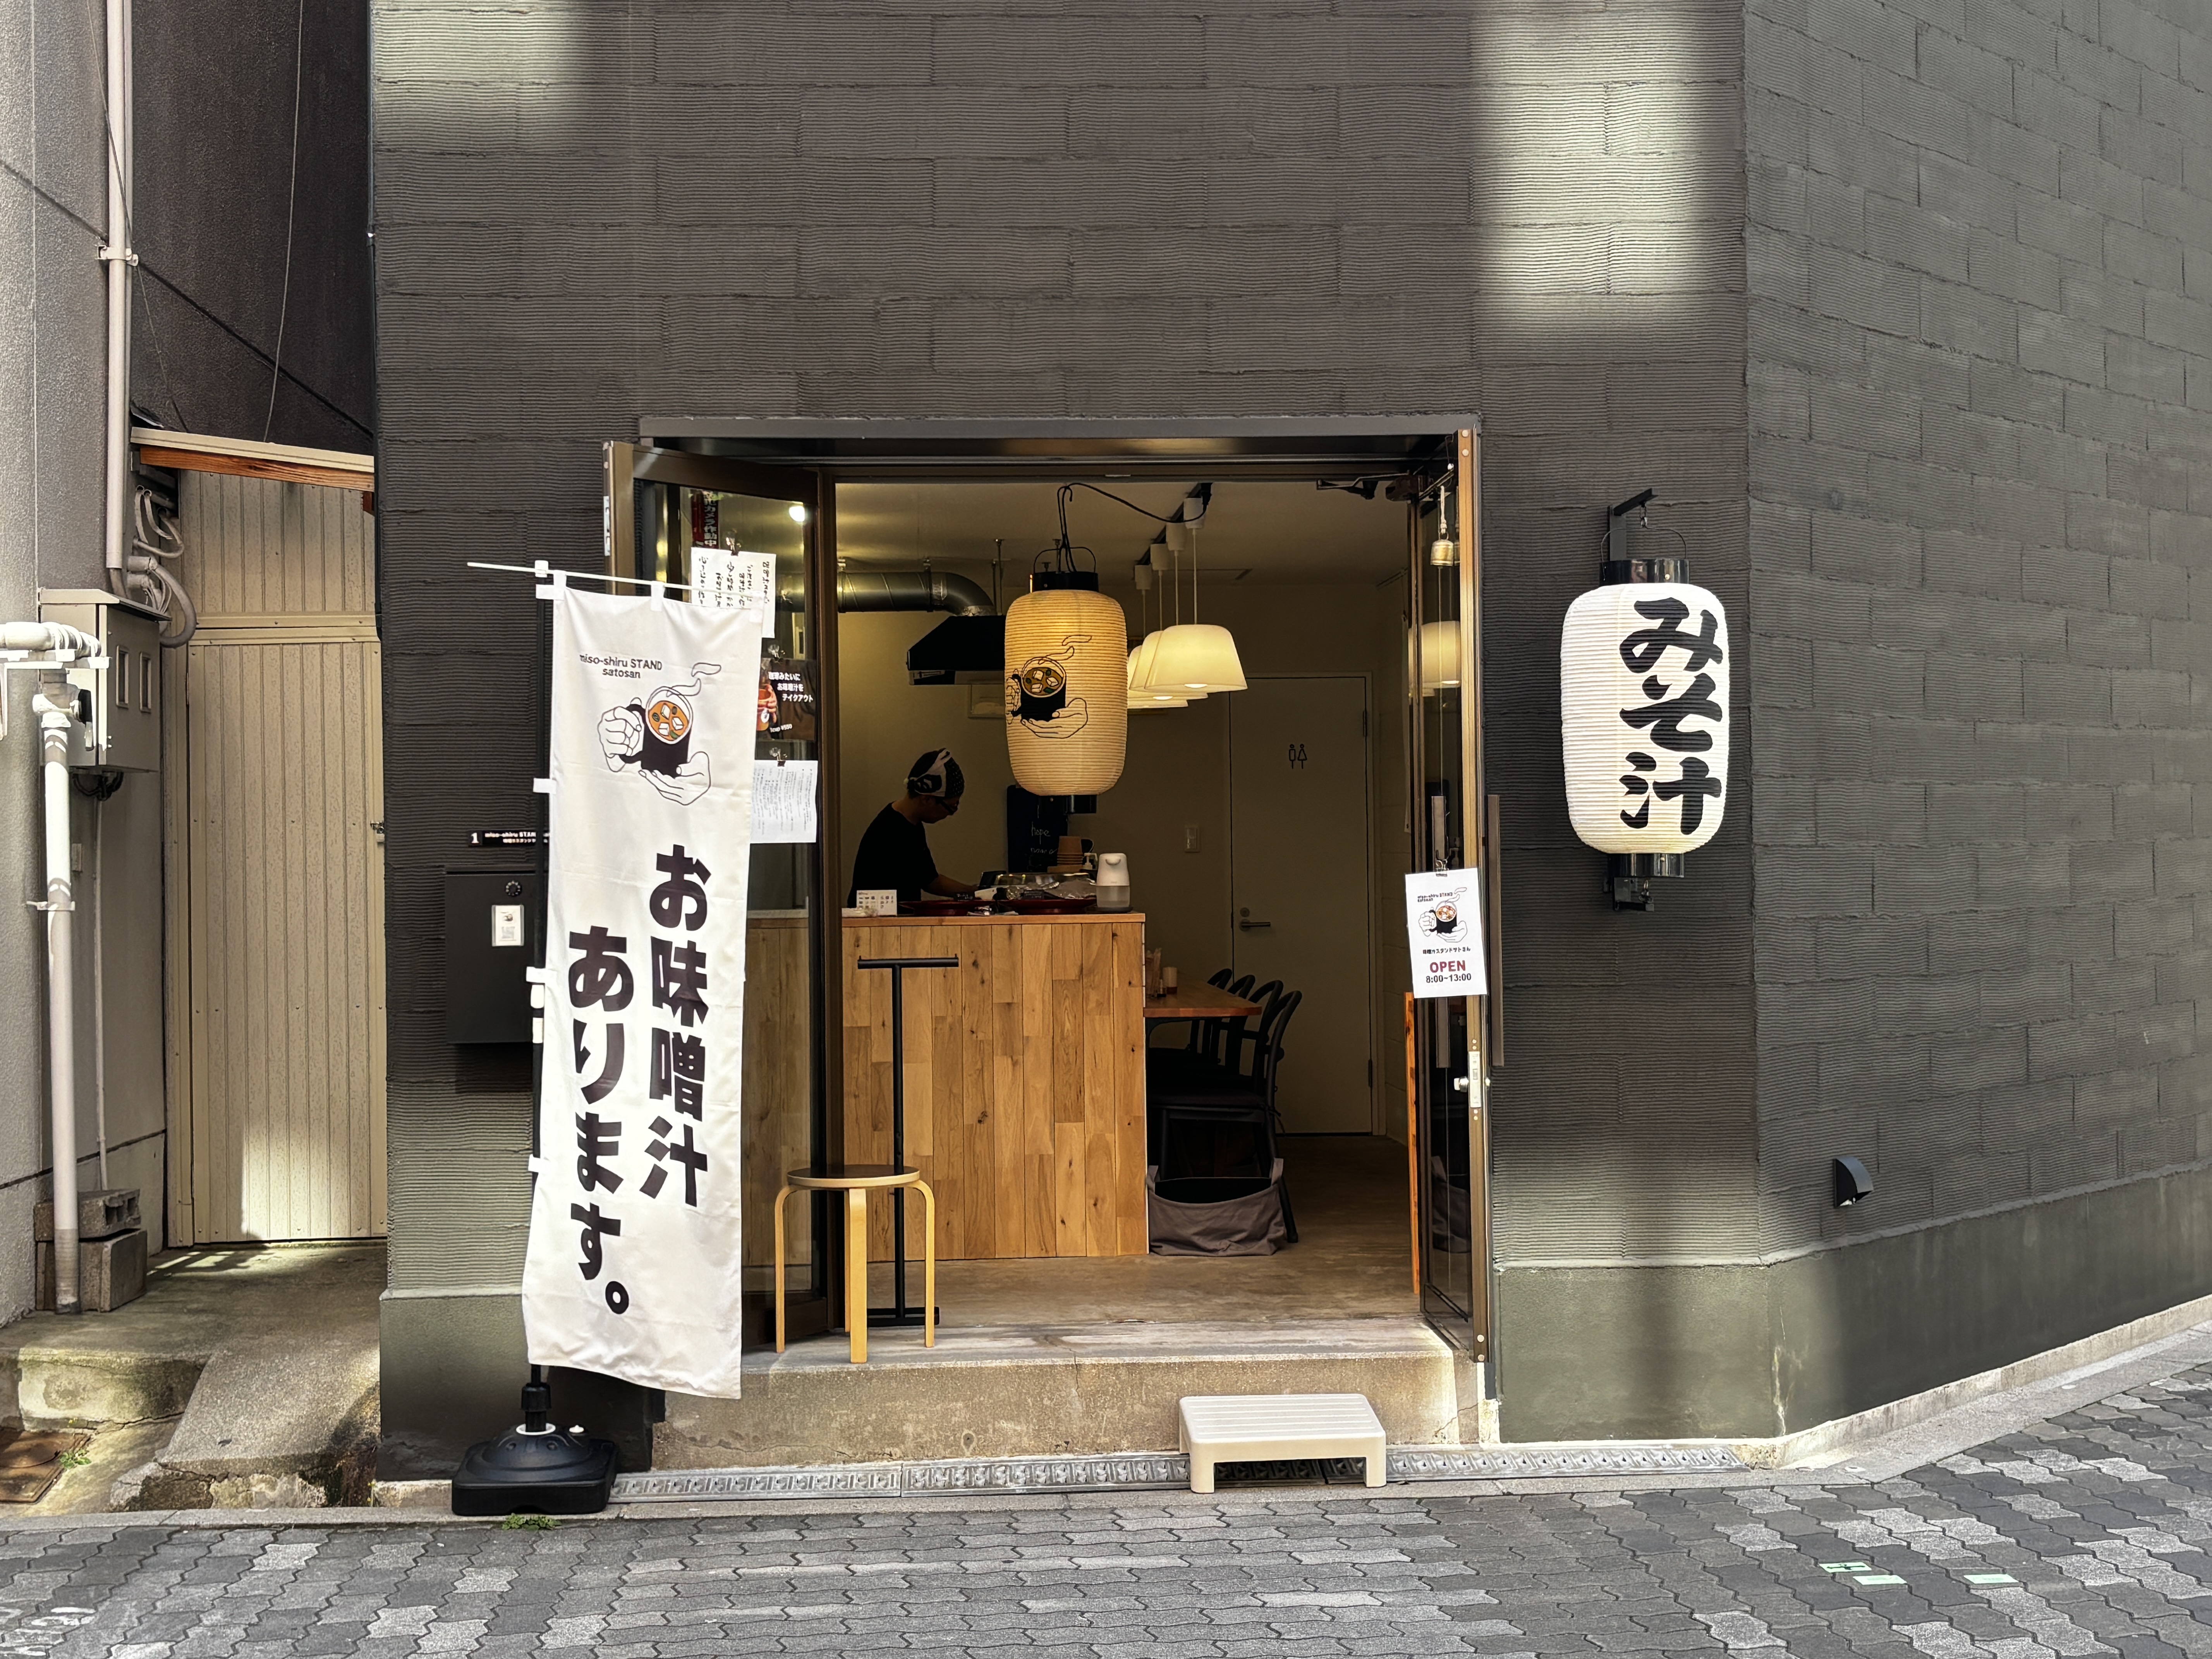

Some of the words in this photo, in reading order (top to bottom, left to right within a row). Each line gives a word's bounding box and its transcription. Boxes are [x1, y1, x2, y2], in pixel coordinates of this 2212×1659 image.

[579, 654, 628, 667] miso-shiru
[630, 659, 663, 671] STAND
[602, 668, 641, 678] satosan
[782, 694, 813, 703] テイクアウト
[1619, 597, 1723, 835] みそ汁
[471, 833, 479, 843] 1
[1031, 821, 1051, 845] hope
[1430, 960, 1466, 973] OPEN
[639, 844, 712, 1207] お味噌汁
[568, 925, 634, 1315] あります。
